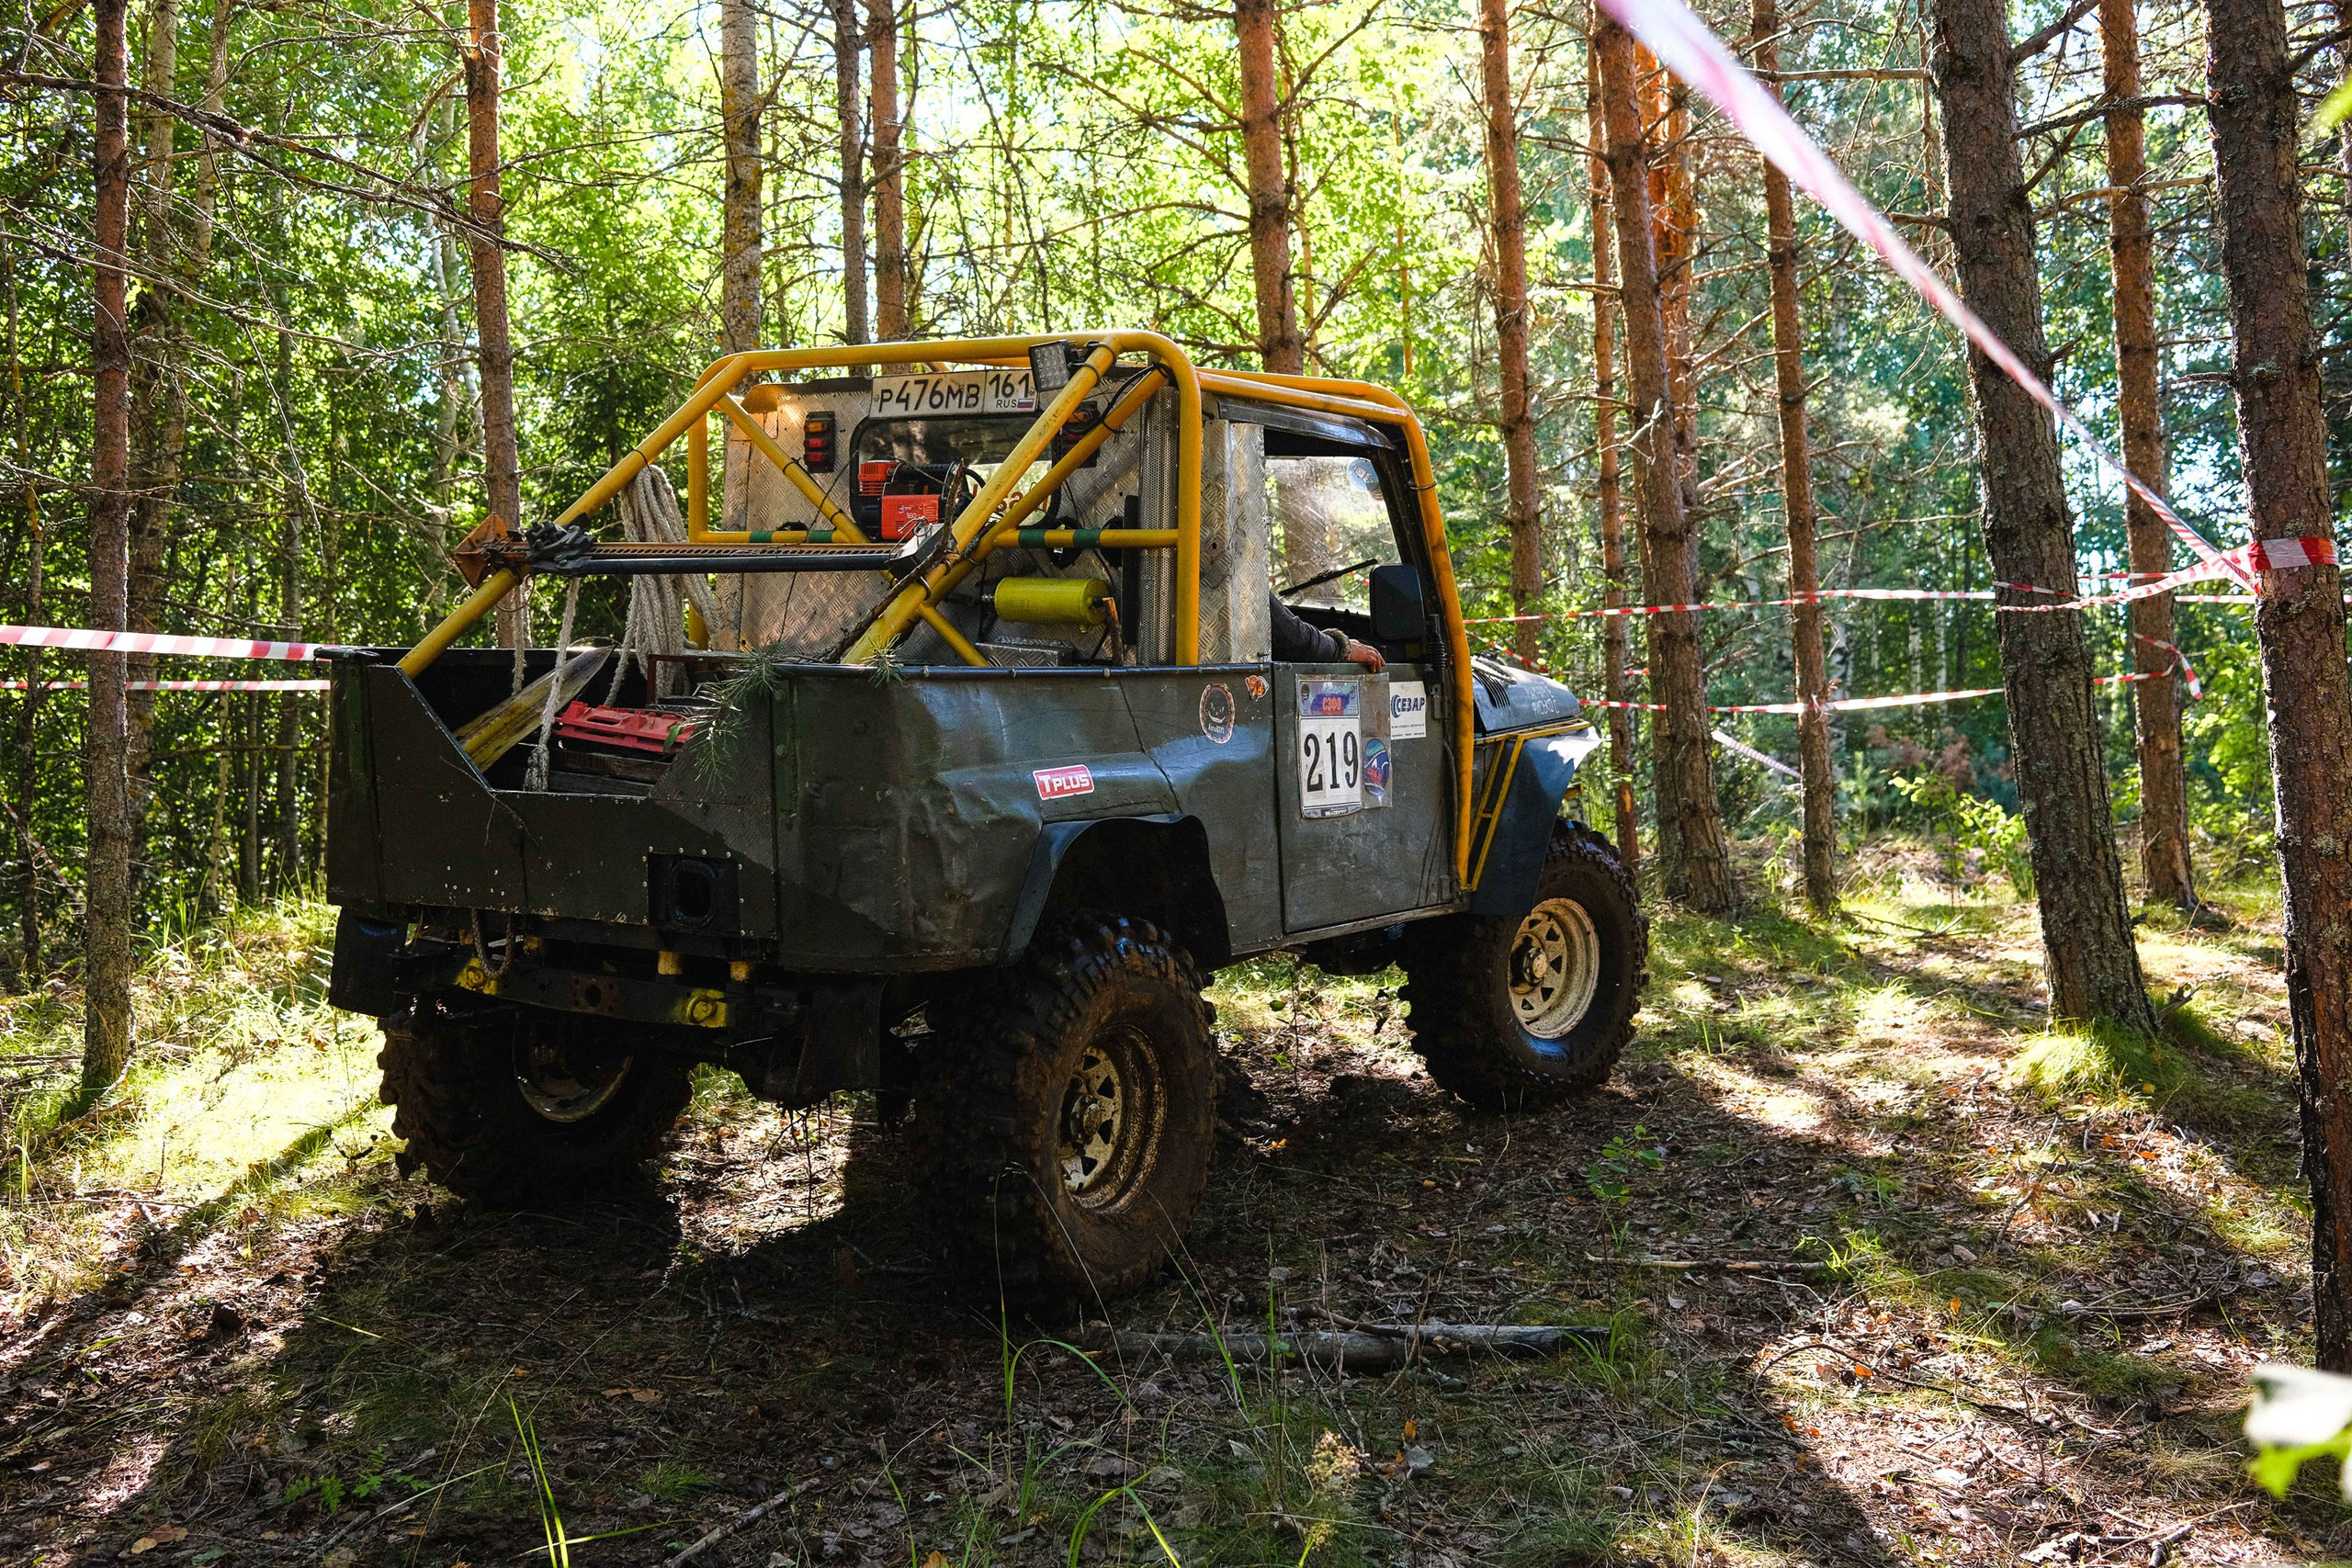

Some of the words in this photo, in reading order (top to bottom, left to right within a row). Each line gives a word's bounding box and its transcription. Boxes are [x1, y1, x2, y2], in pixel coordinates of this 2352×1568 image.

[988, 373, 1030, 398] 161
[996, 398, 1017, 409] RUS
[1303, 730, 1359, 793] 219
